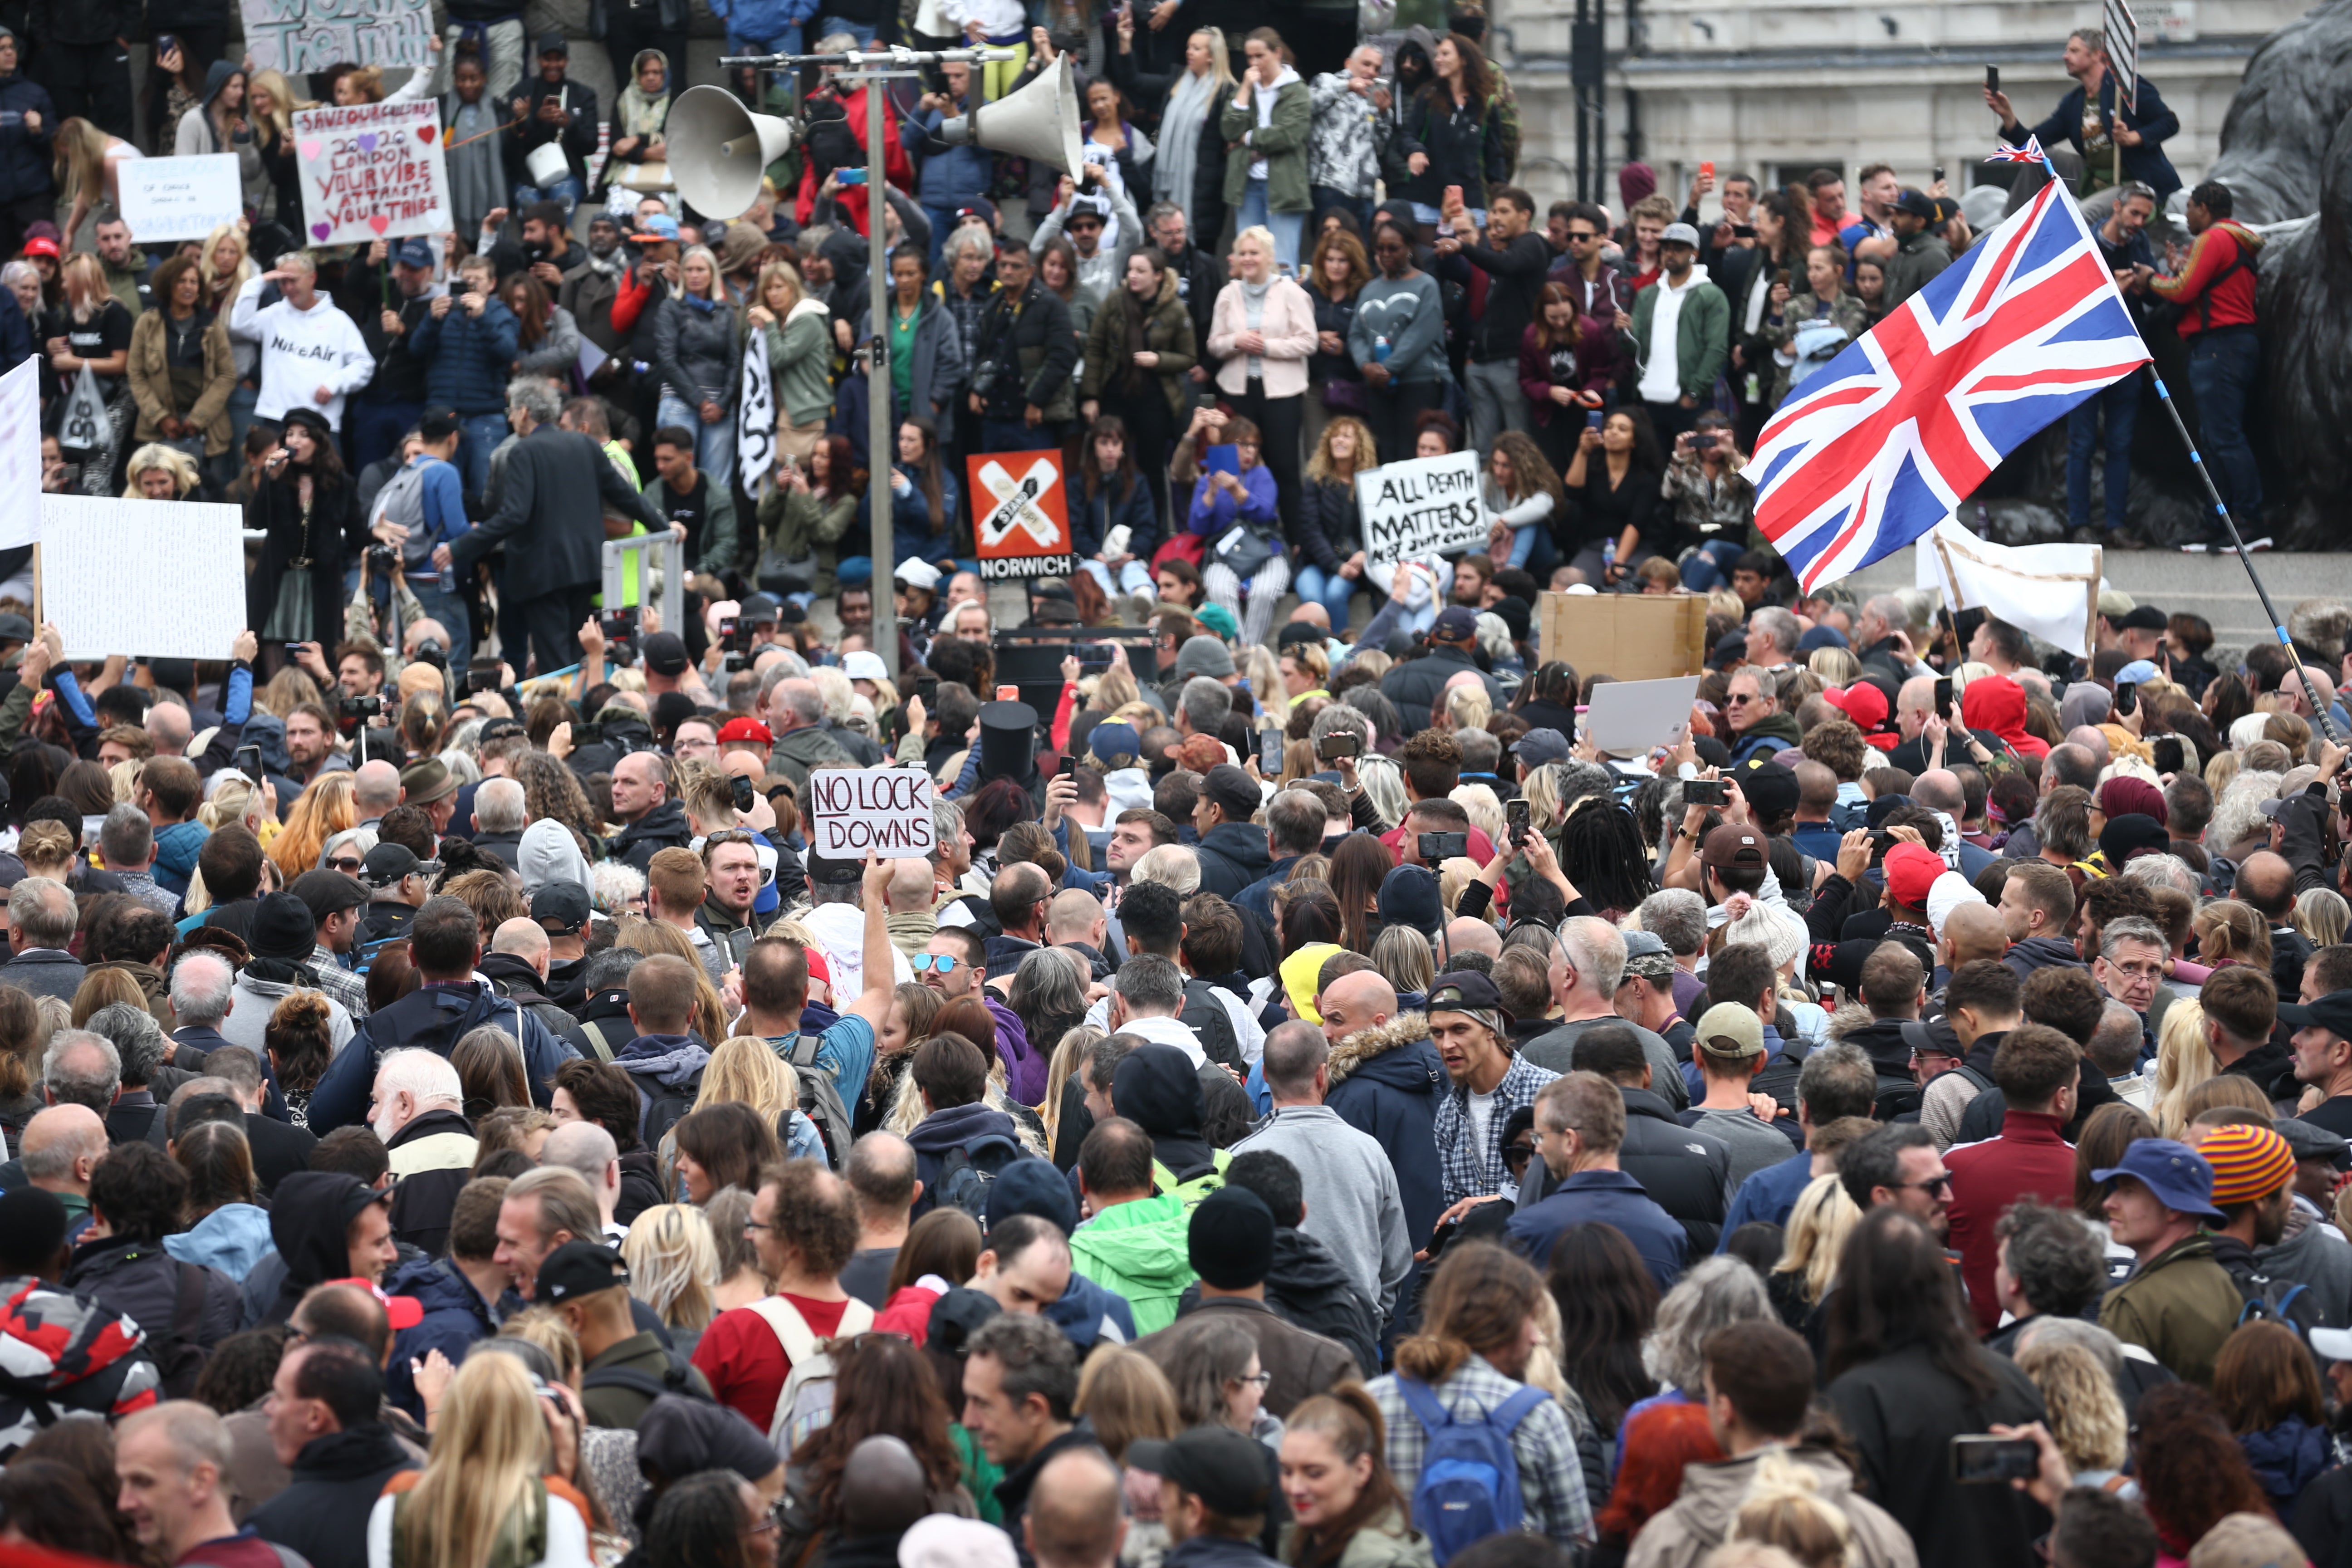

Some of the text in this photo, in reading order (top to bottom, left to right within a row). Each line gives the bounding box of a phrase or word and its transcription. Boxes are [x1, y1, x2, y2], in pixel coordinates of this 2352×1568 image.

[302, 110, 343, 131] SAVE
[347, 104, 378, 124] OUR
[331, 146, 410, 172] LONDON
[316, 160, 429, 200] YOUR VIBE
[326, 195, 438, 230] YOUR TRIBE
[271, 335, 337, 361] Nike Air
[1376, 468, 1474, 508] ALL DEATH
[997, 491, 1029, 525] STAND
[1372, 498, 1477, 544] MATTERS
[979, 555, 1072, 580] NORWICH
[1373, 541, 1401, 564] NOT
[814, 775, 929, 812] NO LOCK
[828, 817, 930, 849] DOWNS
